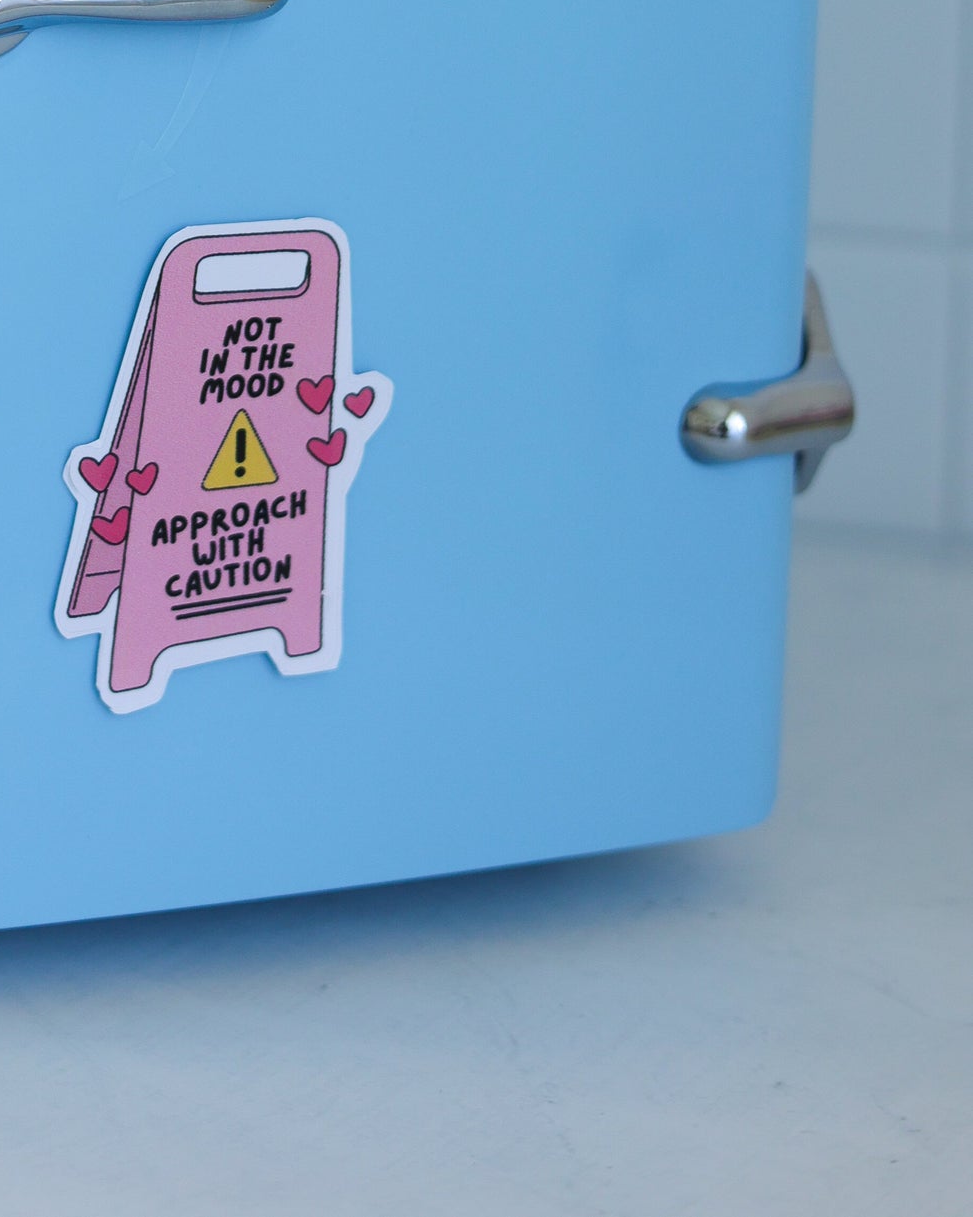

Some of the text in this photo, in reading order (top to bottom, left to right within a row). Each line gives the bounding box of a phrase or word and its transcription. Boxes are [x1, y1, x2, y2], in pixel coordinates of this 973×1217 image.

[223, 316, 283, 347] NOT
[199, 342, 295, 377] IN THE
[199, 372, 285, 405] MOOD
[151, 489, 307, 547] APPROACH
[192, 526, 265, 566] WITH
[165, 553, 292, 599] CAUTION
